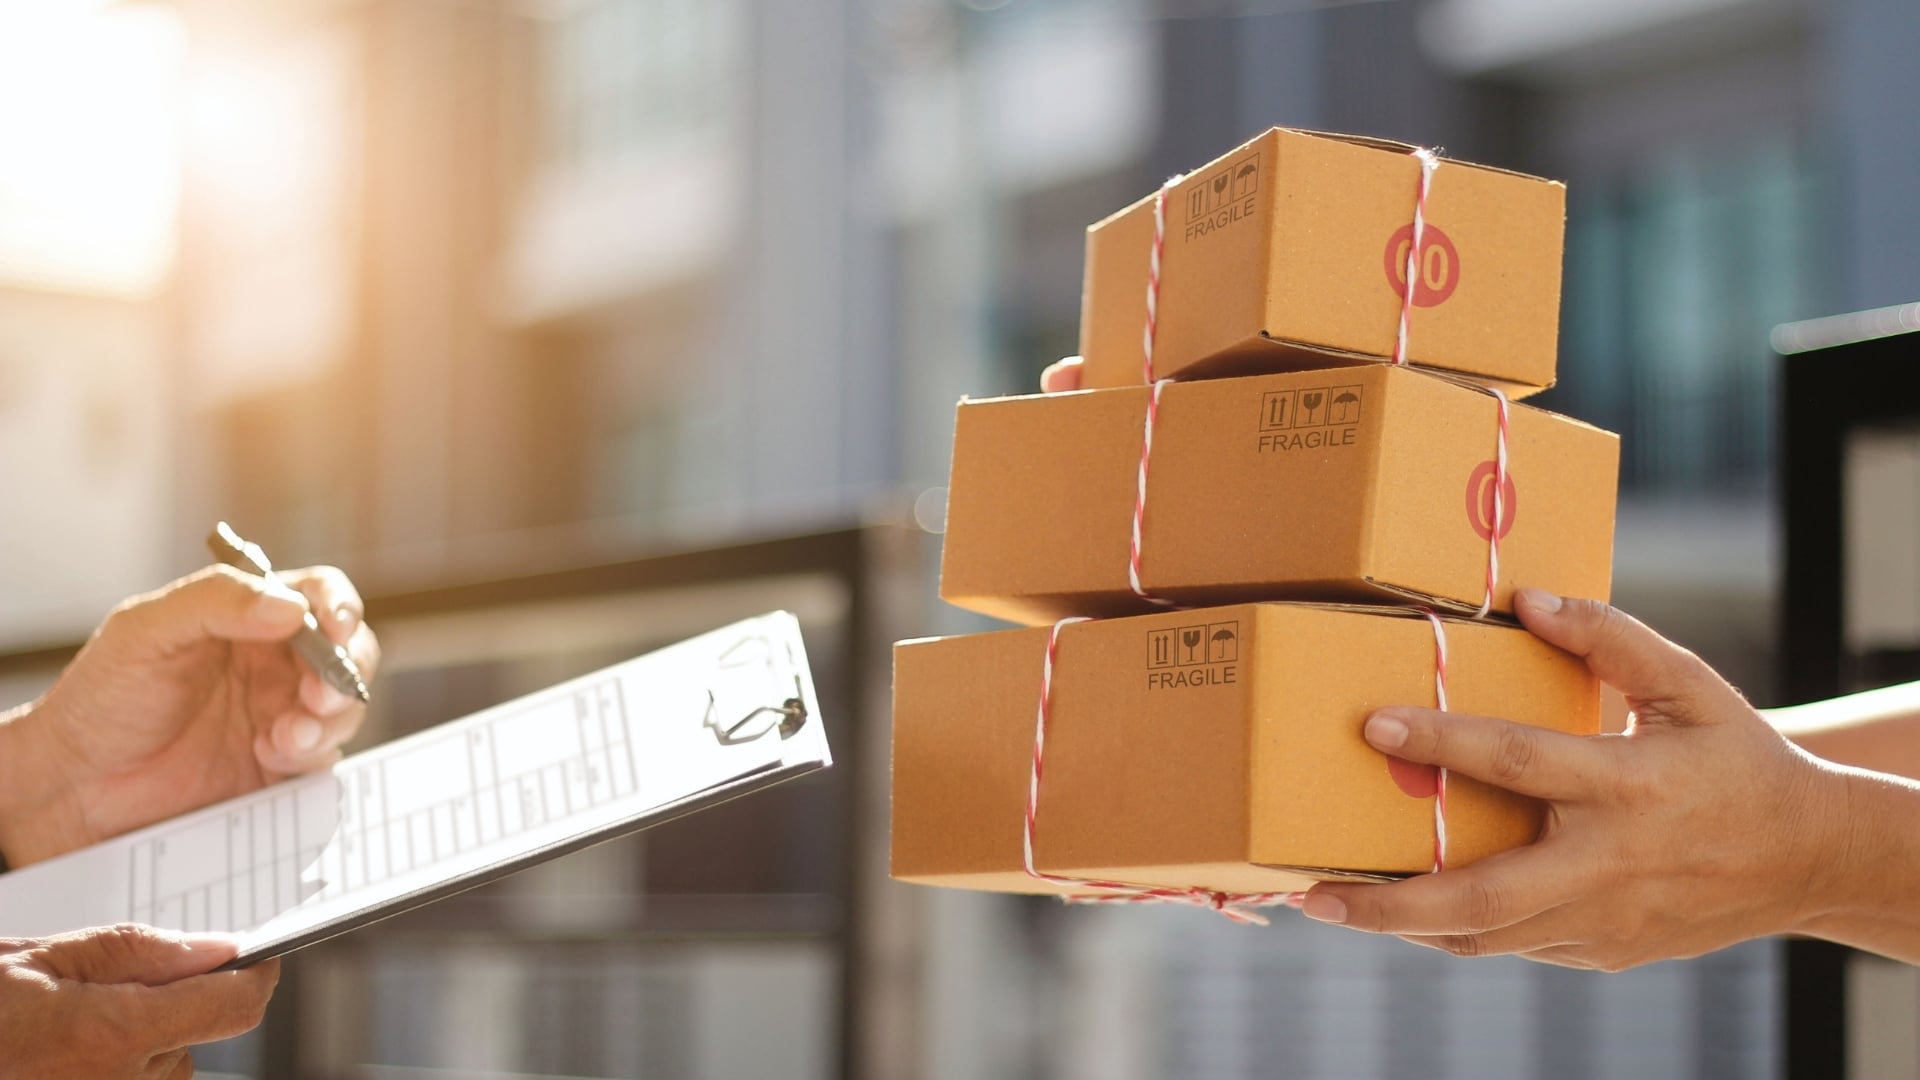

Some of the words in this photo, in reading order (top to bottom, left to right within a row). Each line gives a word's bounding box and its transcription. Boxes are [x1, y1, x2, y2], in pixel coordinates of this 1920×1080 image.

[1185, 197, 1255, 243] FRAGILE
[1258, 428, 1357, 453] FRAGILE
[1148, 666, 1237, 690] FRAGILE
